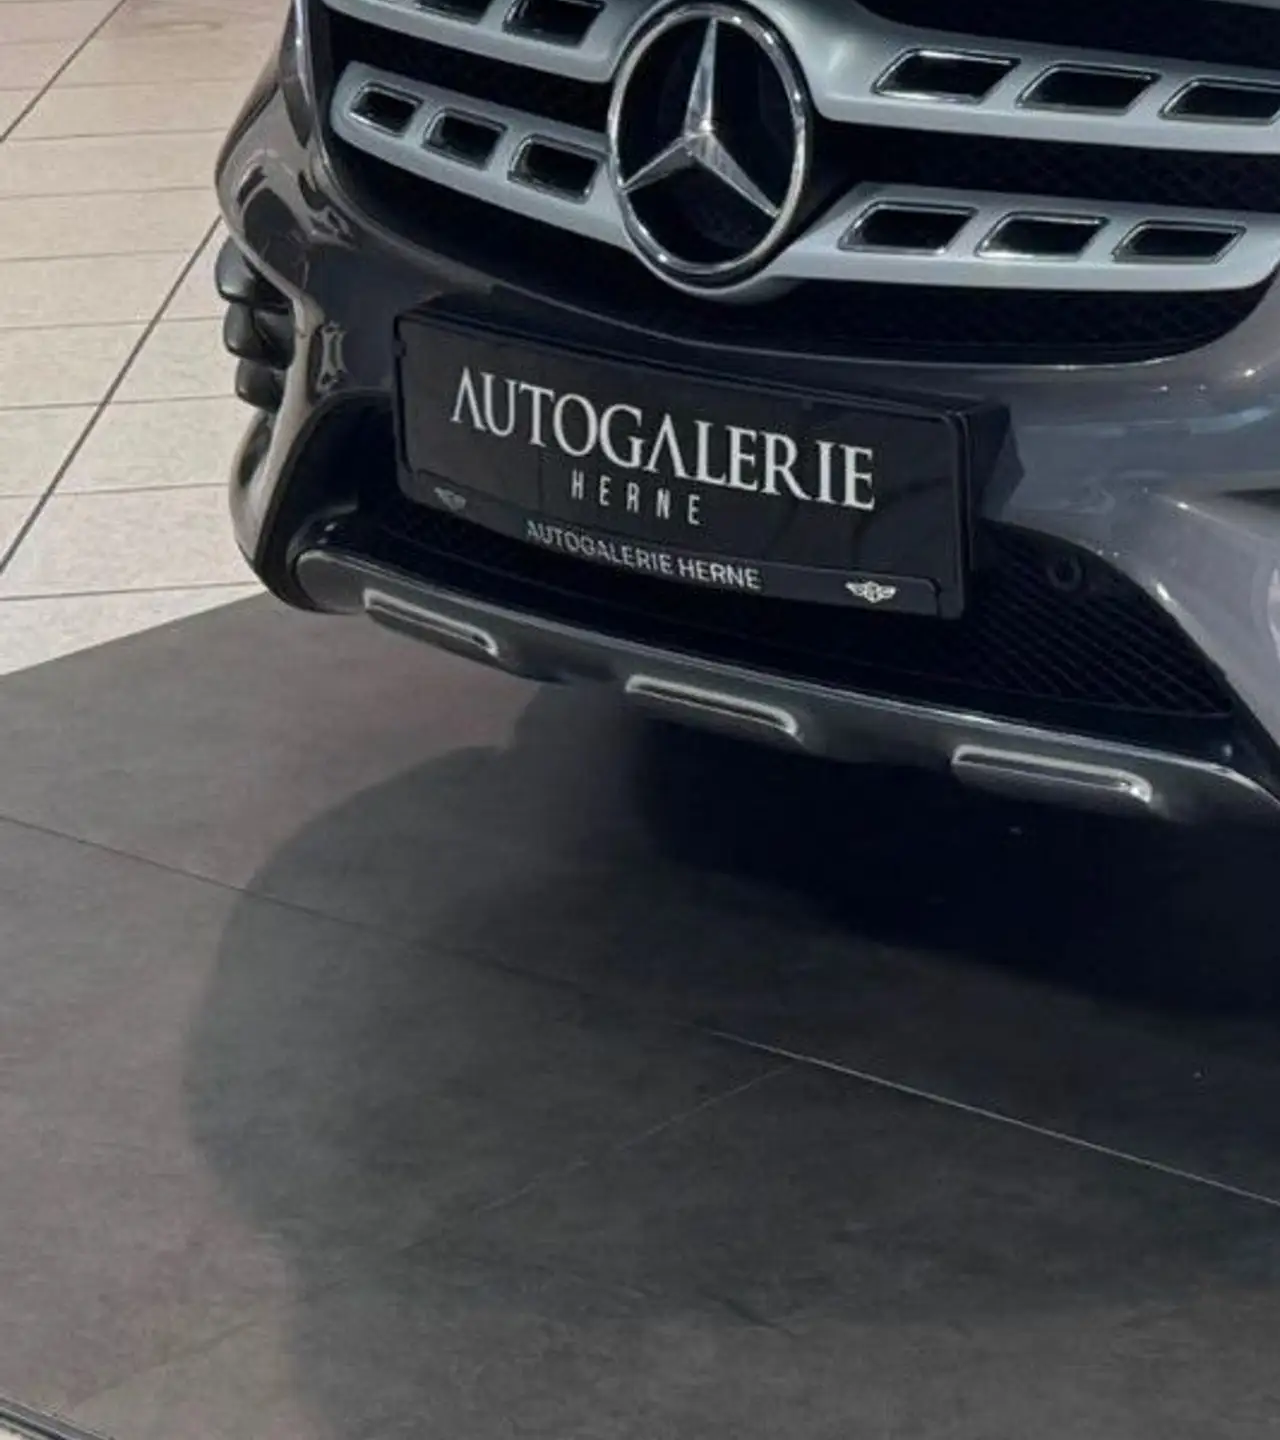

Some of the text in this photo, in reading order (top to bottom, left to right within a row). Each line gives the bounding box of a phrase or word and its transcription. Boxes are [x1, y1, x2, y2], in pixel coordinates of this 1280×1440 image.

[450, 366, 876, 511] AUTOGALERIE
[571, 468, 701, 526] HERNE
[527, 519, 763, 591] AUTOGALERIE HERNE
